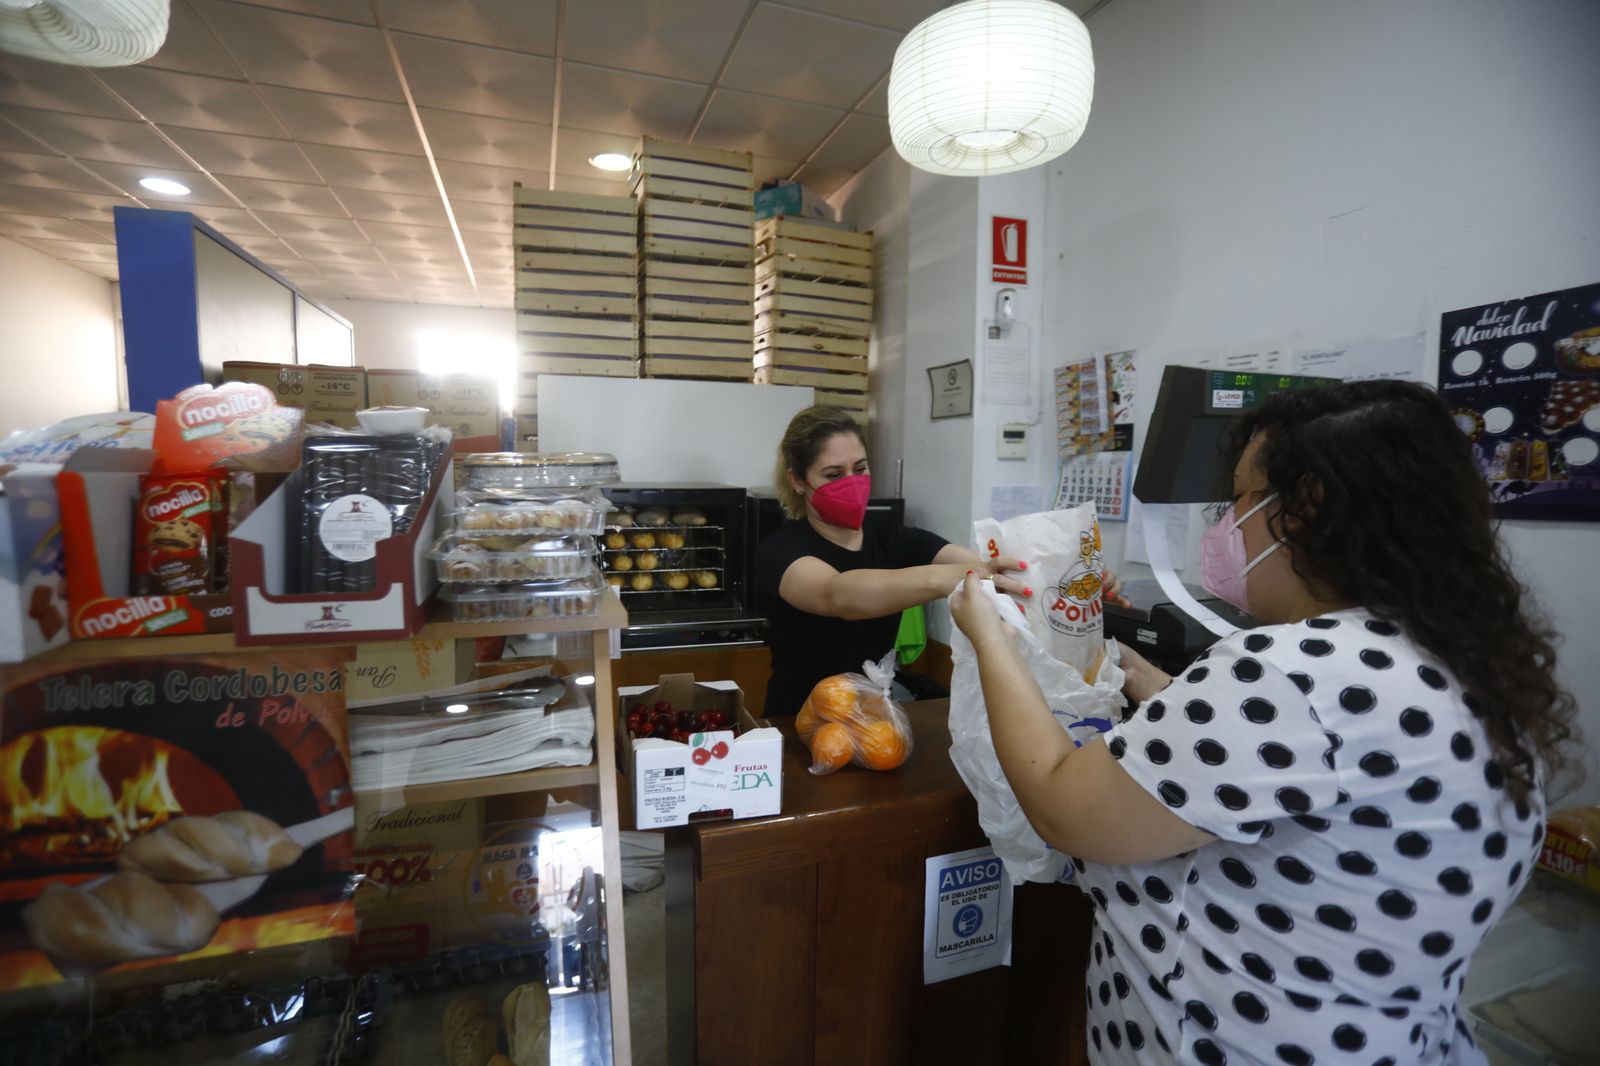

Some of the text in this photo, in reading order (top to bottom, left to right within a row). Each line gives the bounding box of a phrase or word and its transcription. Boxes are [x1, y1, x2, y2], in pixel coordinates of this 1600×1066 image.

[1451, 300, 1559, 347] Navidad
[1476, 306, 1512, 326] dulce
[184, 393, 262, 425] nocilla
[148, 488, 204, 518] nocilla
[83, 595, 167, 637] nocilla
[38, 664, 344, 713] Telera Cordobesa
[355, 665, 397, 688] Pan
[215, 703, 247, 729] de
[734, 764, 768, 773] Frutas
[366, 802, 467, 833] Tradicional
[482, 851, 517, 866] MASA
[941, 862, 999, 889] AVISO
[940, 883, 1000, 902] ES OBLIGATORIO
[962, 895, 977, 904] USO
[978, 892, 988, 901] DE
[939, 933, 995, 953] MASCARILLA
